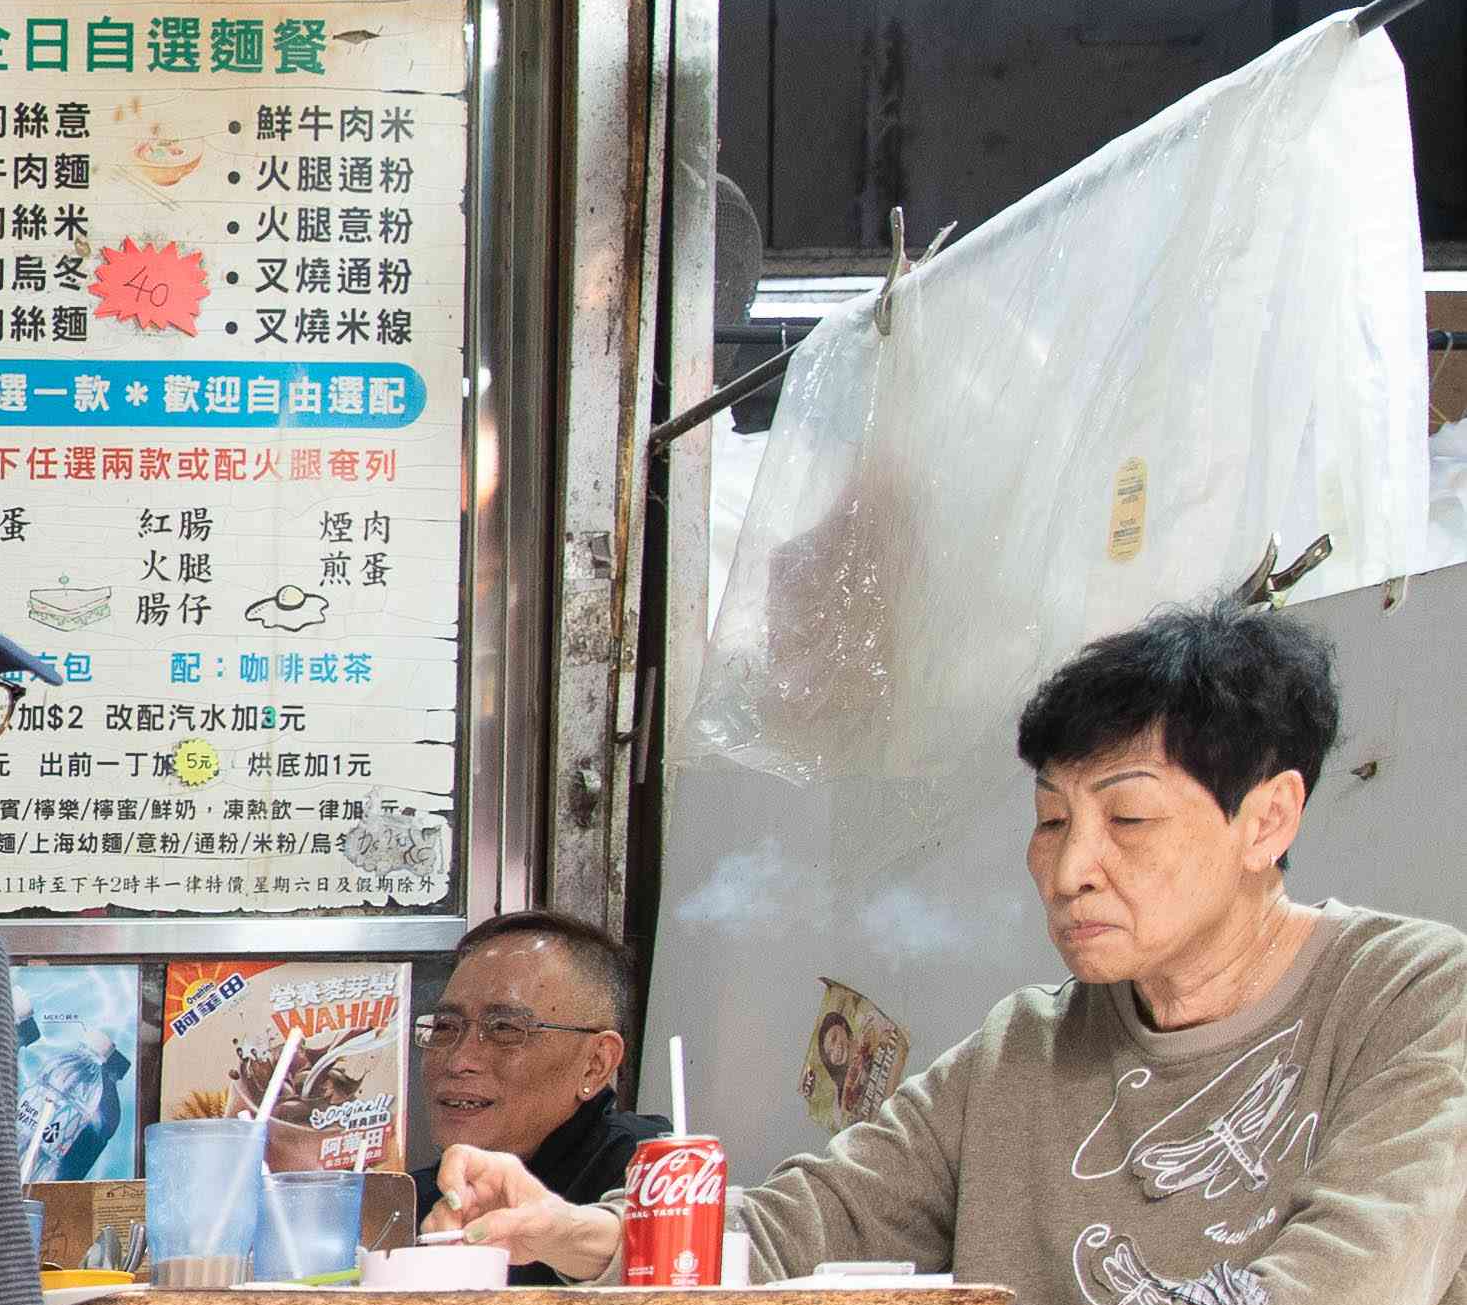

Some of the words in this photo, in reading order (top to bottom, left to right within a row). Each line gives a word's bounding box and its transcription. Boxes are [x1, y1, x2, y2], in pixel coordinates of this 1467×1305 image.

[255, 104, 416, 142] 鮮牛肉米
[255, 155, 414, 194] 火腿通粉
[255, 205, 414, 245] 火腿意粉
[124, 264, 171, 308] 40
[254, 255, 413, 295] 叉燒通粉
[254, 306, 413, 346] 叉燒米線
[136, 507, 213, 541] 紅腸
[318, 509, 392, 543] 煙肉
[139, 551, 213, 585] 火腿
[318, 552, 393, 588] 煎蛋
[136, 592, 213, 627] 腸仔
[170, 651, 374, 685] 配：咖啡或茶
[105, 702, 307, 733] 改配汽水加3元
[247, 751, 373, 779] 烘底加1元
[251, 875, 436, 896] 星期六日及假期除外
[173, 974, 245, 1036] 阿華田
[271, 997, 398, 1039] WAHH!
